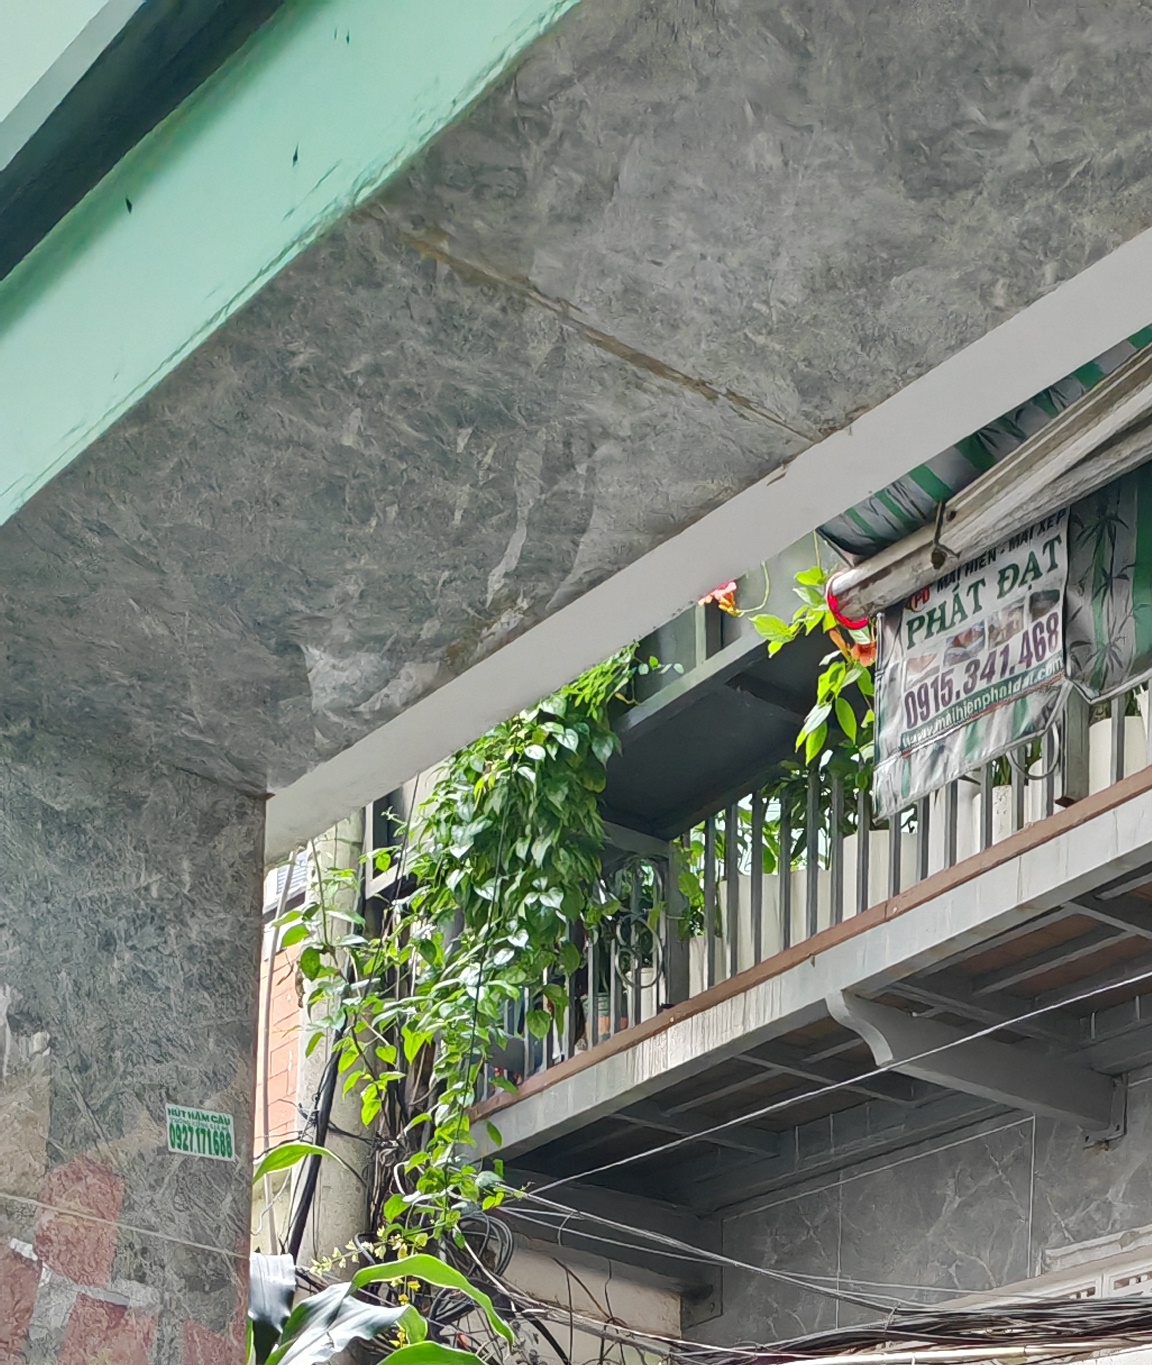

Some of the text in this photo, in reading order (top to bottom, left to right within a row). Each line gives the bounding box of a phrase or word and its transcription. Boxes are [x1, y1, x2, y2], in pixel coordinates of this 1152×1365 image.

[906, 534, 1062, 650] PHÁT ĐẠT
[904, 612, 1060, 729] 0915.341.468
[169, 1122, 233, 1159] 0927.171.688
